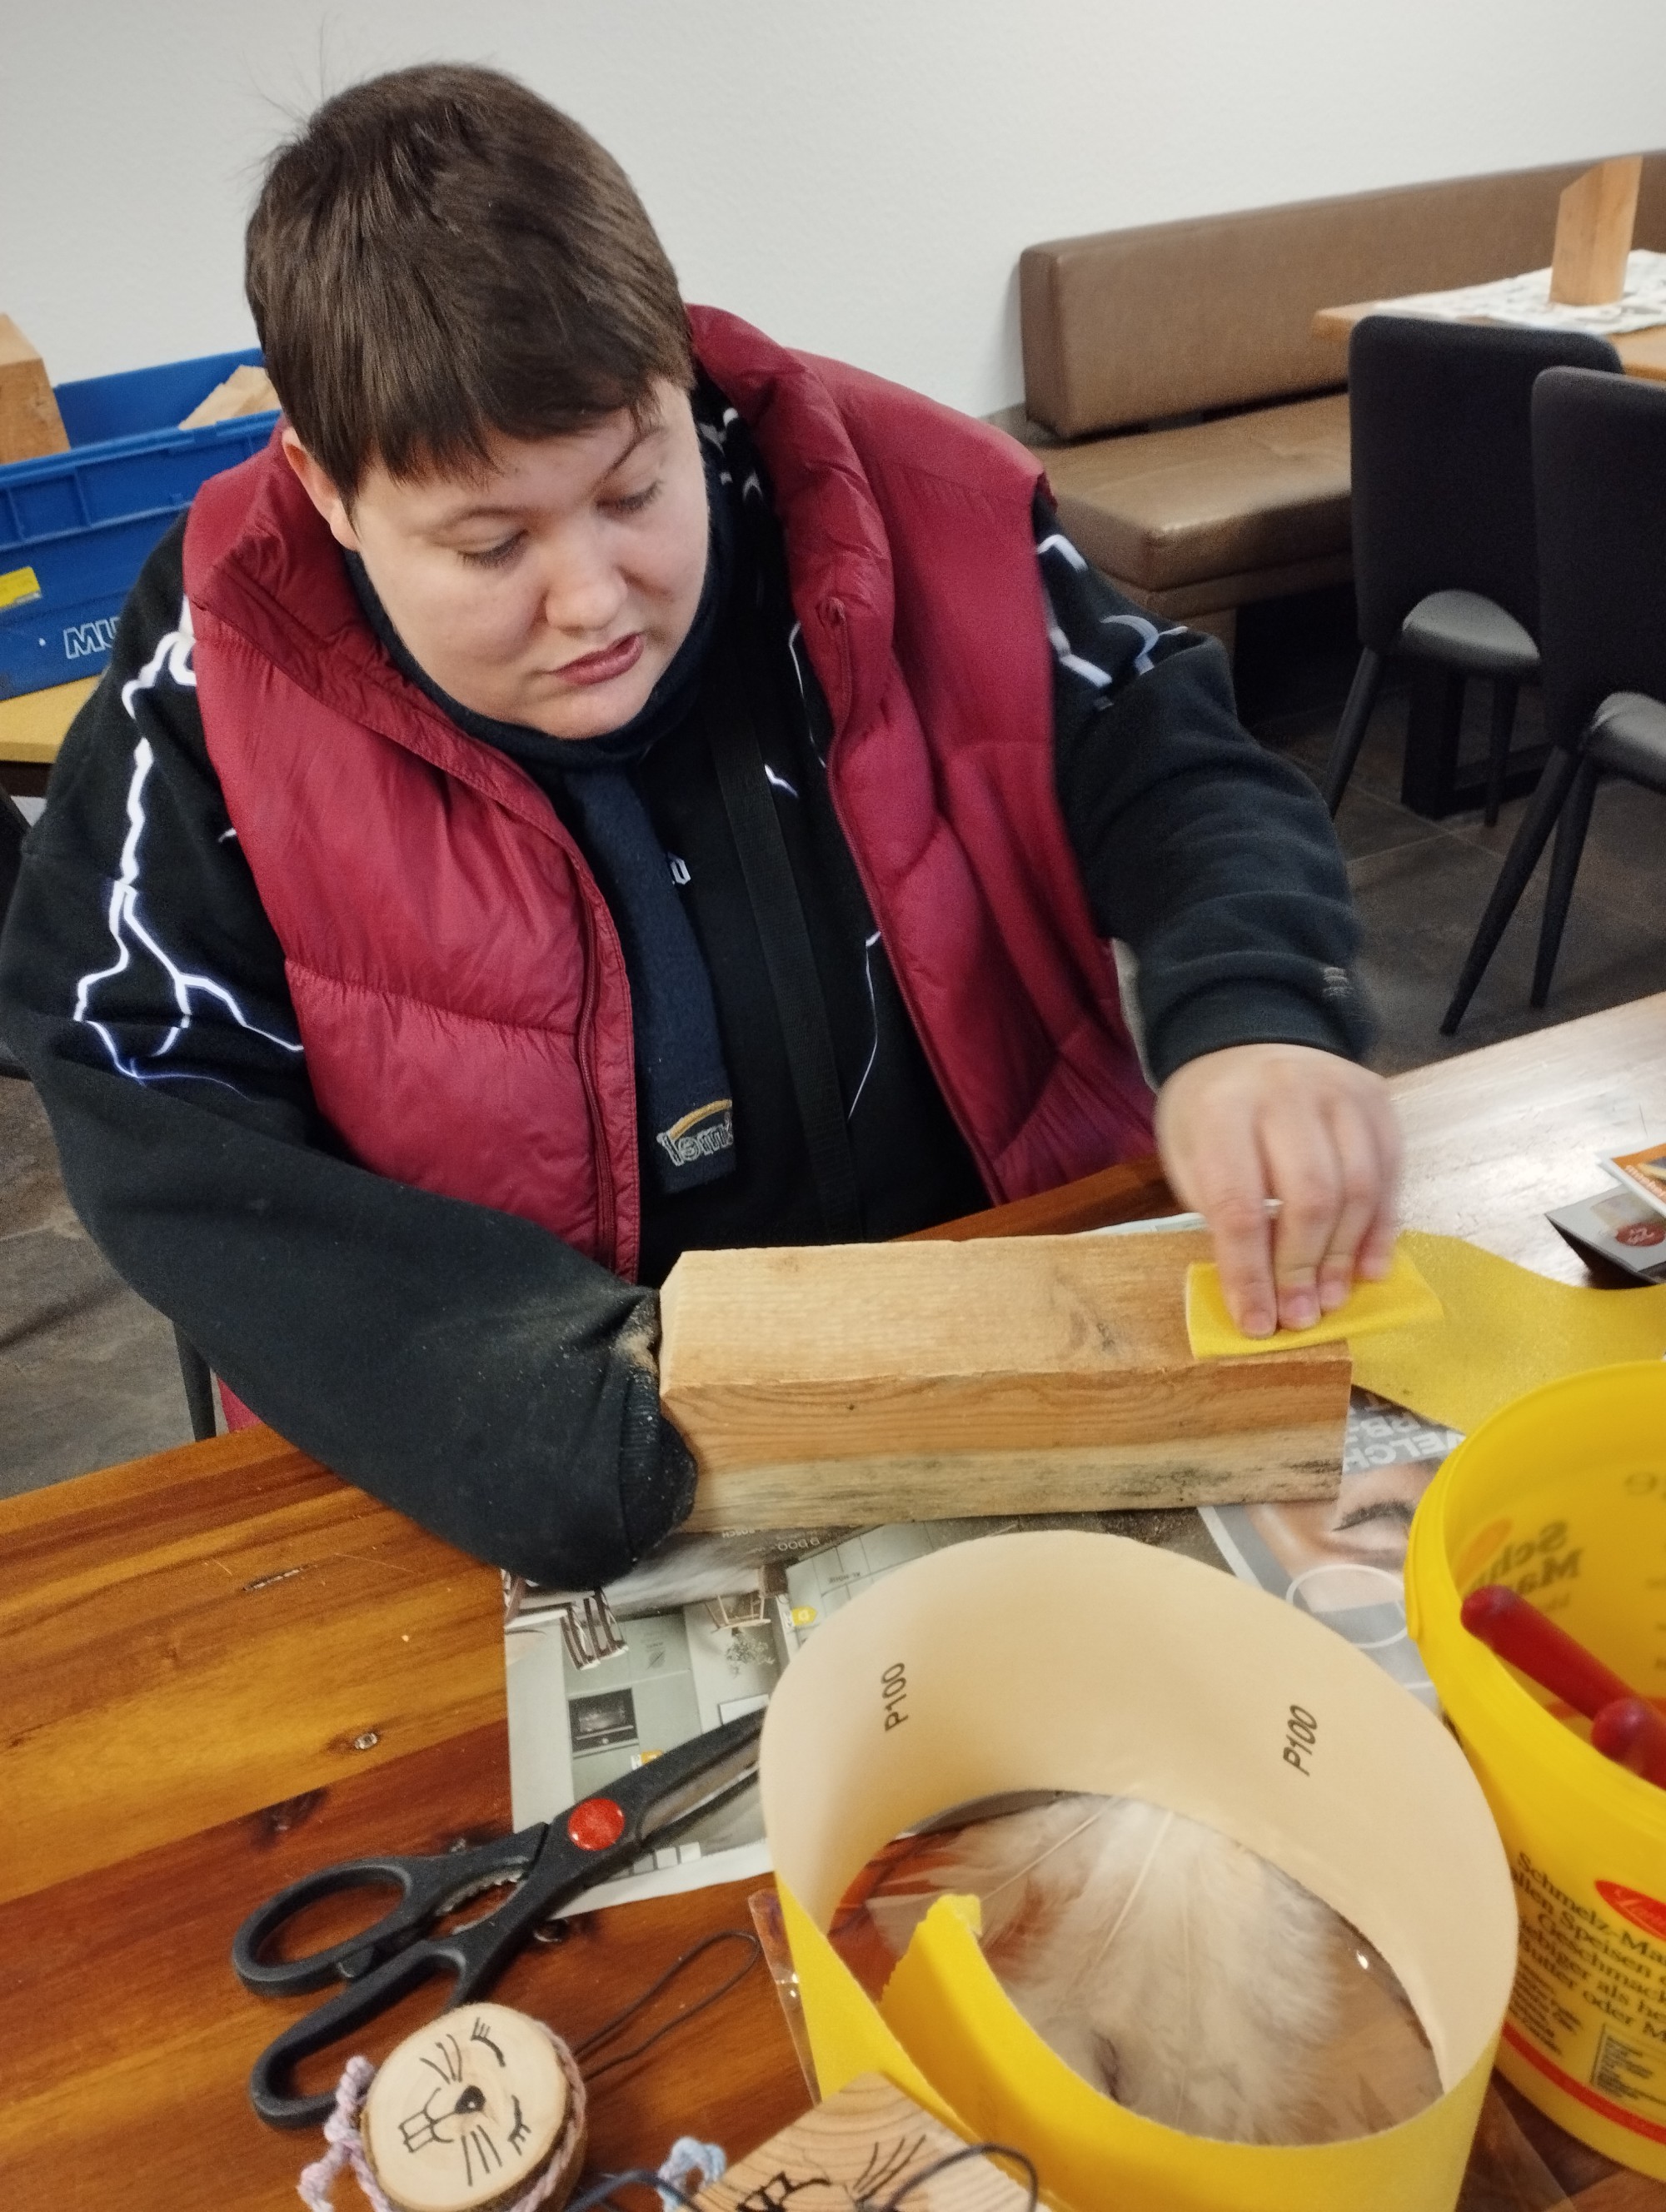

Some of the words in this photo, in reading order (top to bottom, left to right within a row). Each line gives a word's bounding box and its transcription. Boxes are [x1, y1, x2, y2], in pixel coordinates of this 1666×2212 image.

[880, 1663, 909, 1731] P100
[1283, 1705, 1317, 1776] P100
[1583, 1990, 1634, 2025] oder
